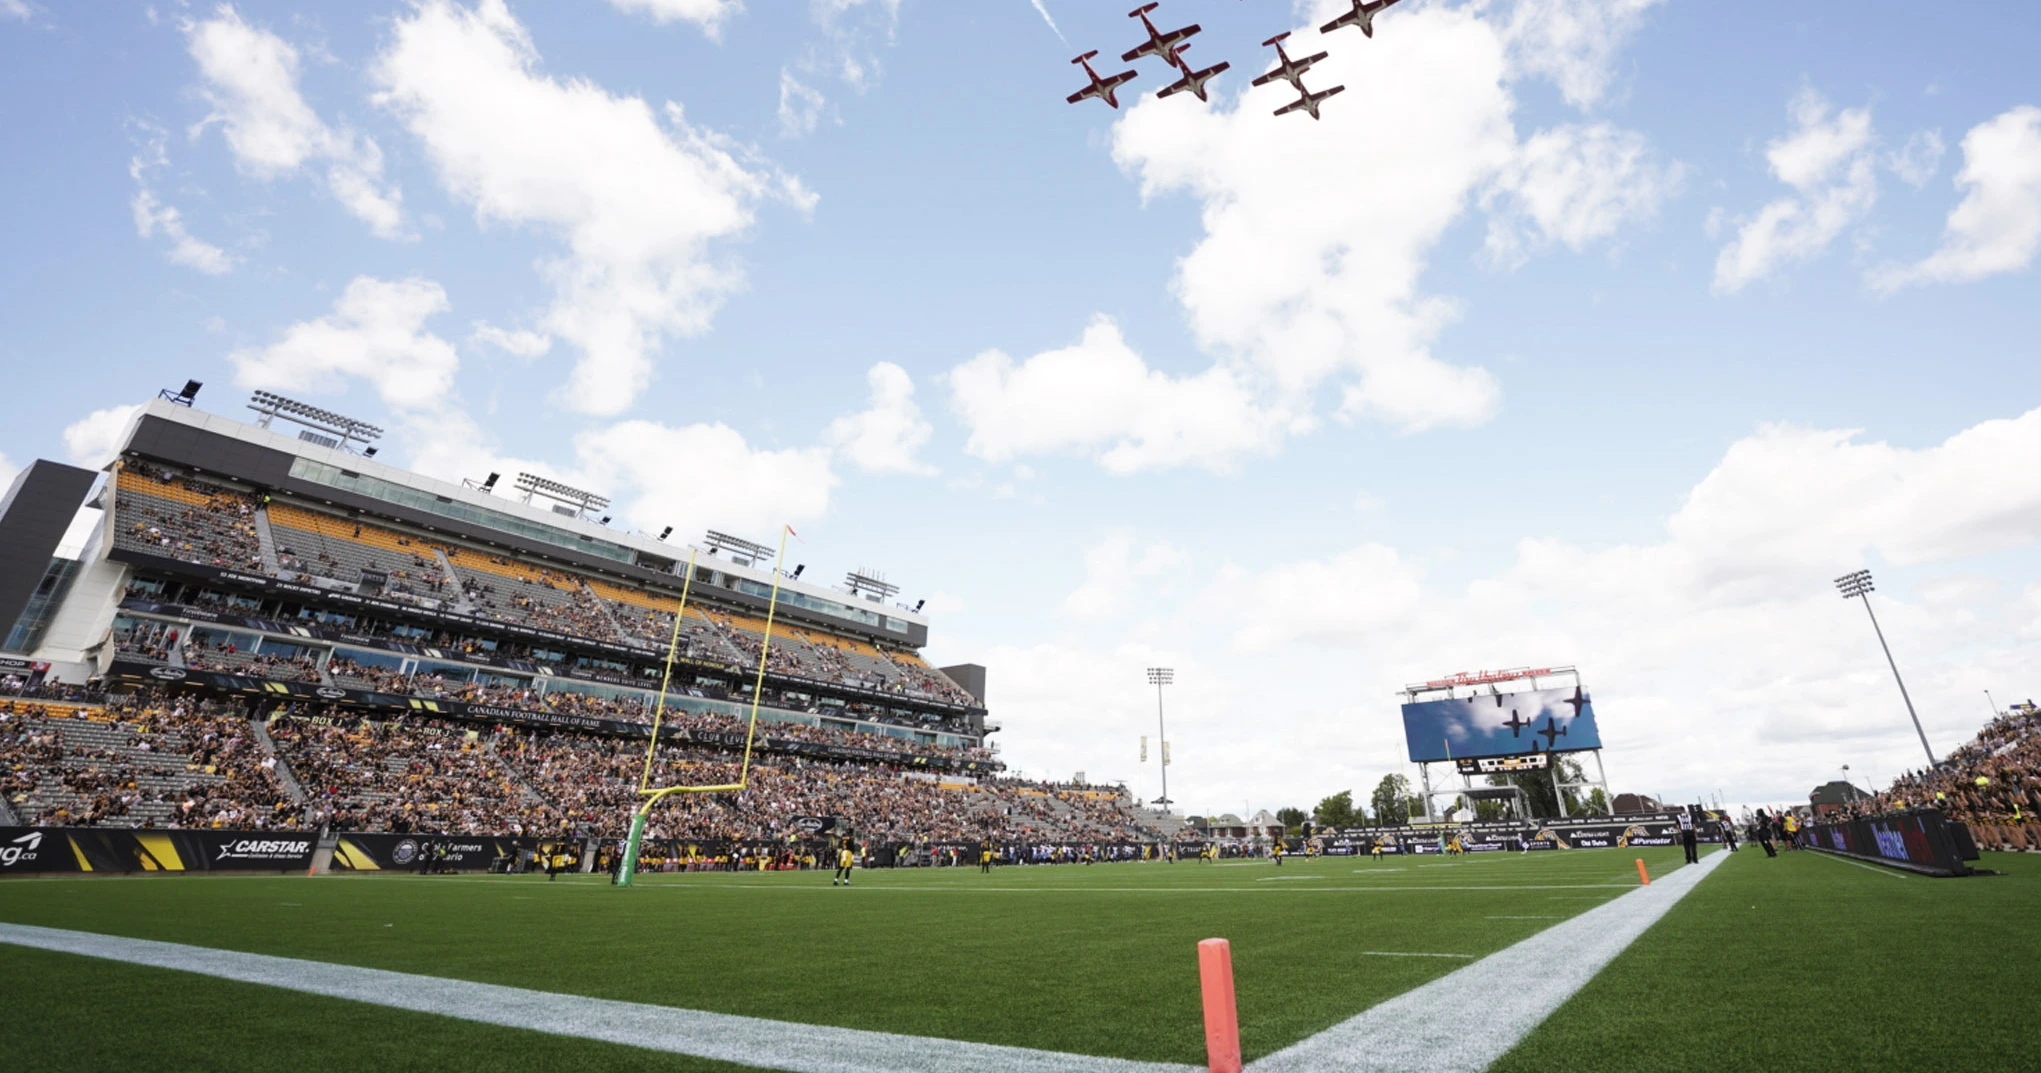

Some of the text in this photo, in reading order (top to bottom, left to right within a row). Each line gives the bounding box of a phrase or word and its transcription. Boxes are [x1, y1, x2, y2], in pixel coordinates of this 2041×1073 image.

[467, 705, 600, 727] CANADIAN FOOTBALL HALL OF FAME
